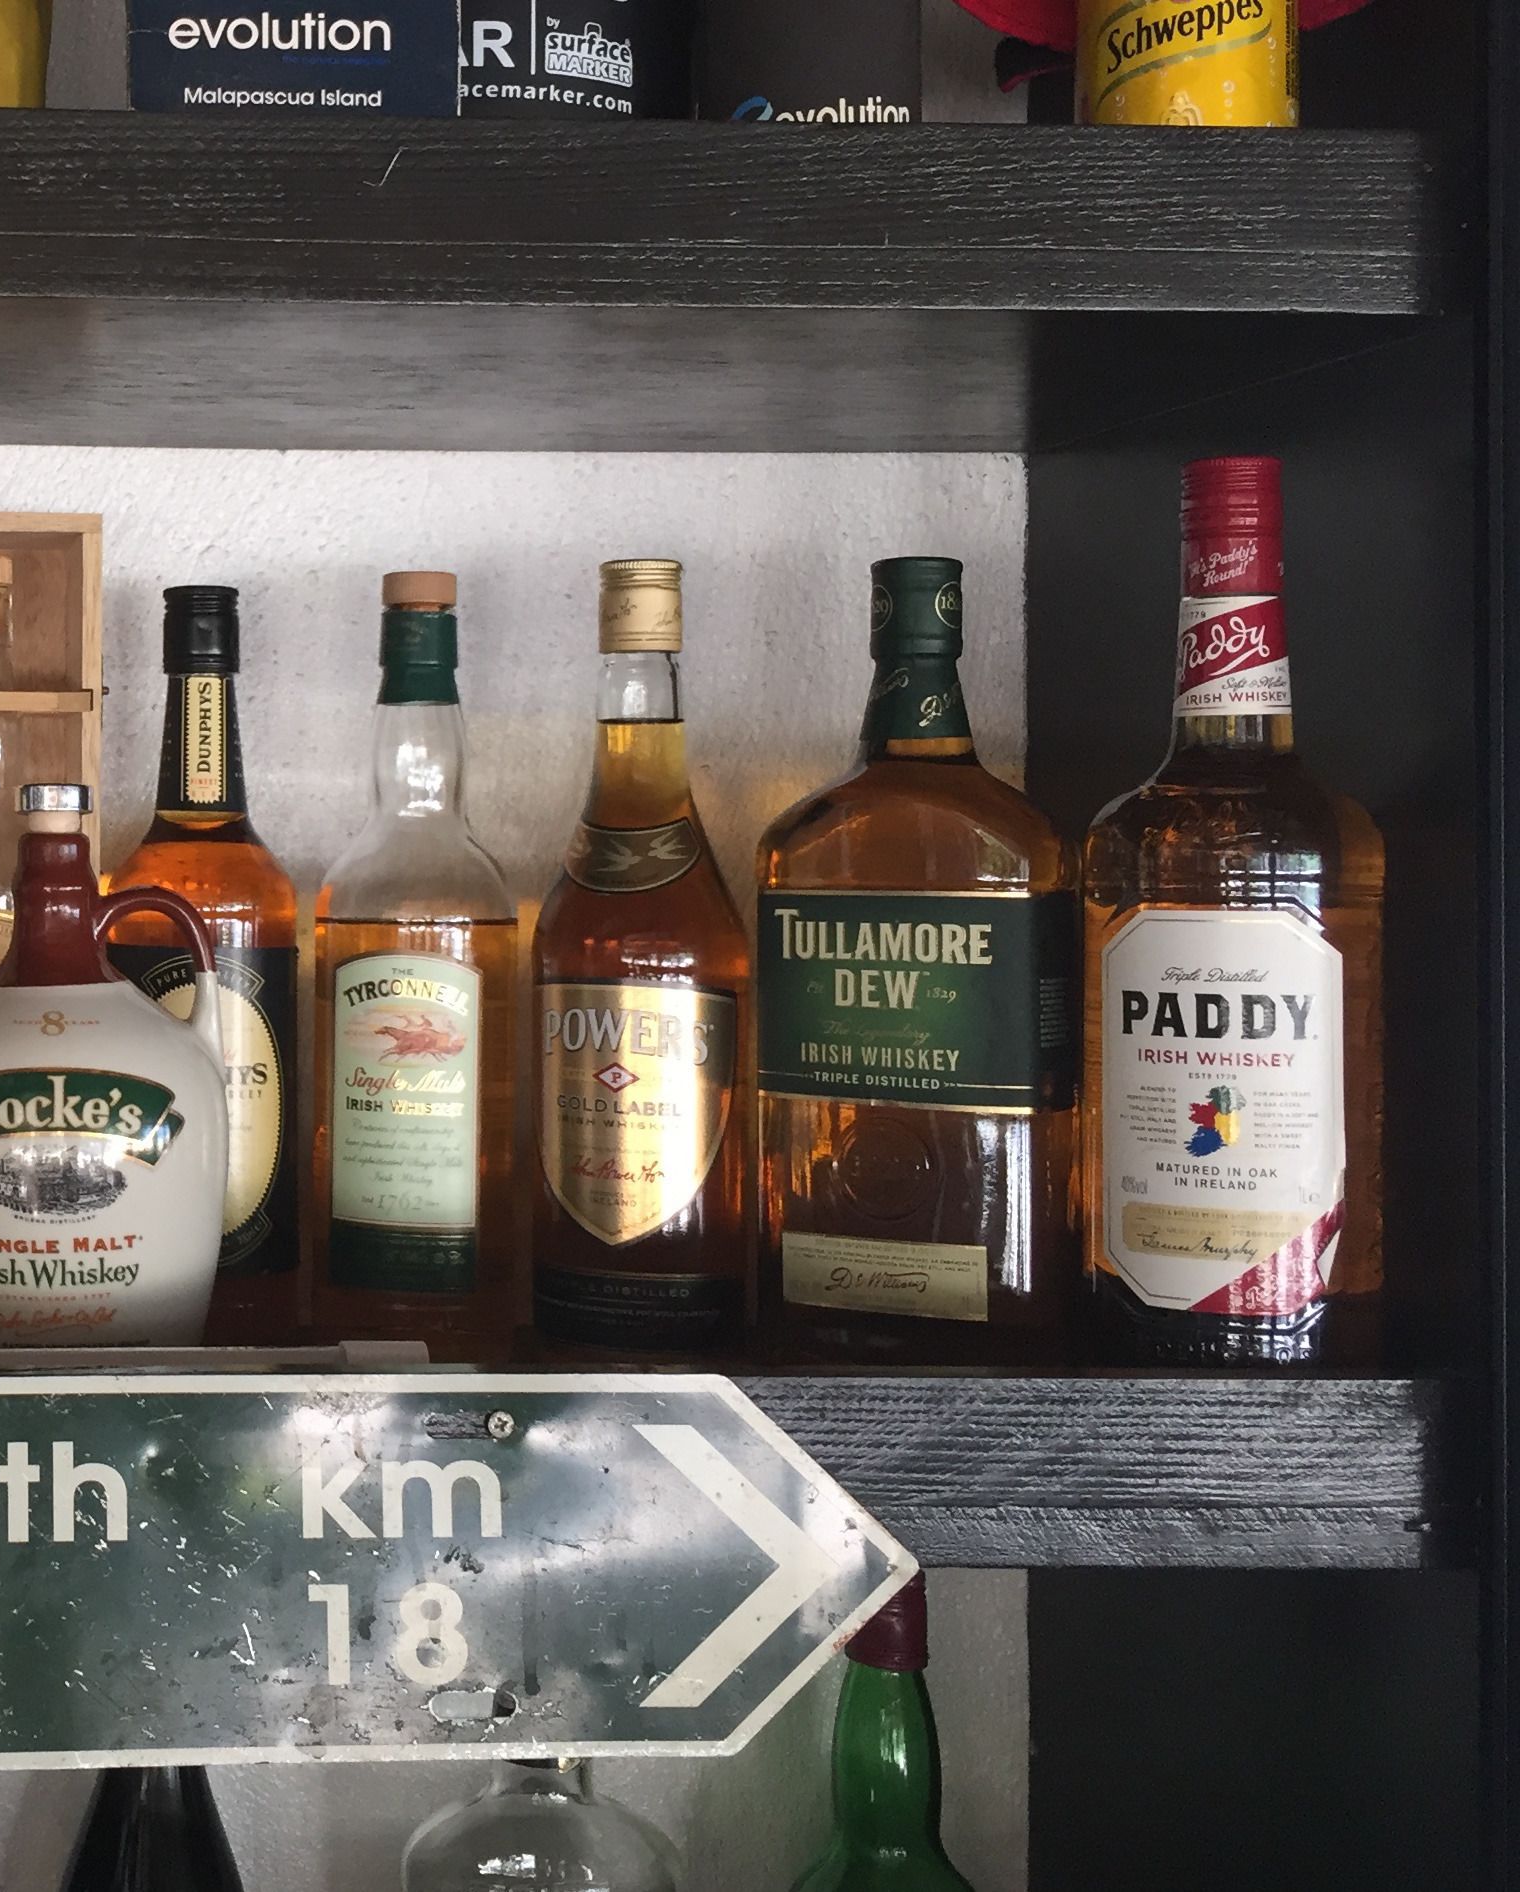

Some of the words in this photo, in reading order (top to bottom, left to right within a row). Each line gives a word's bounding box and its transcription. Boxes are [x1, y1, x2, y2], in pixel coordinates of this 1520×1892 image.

[168, 12, 391, 51] evolution
[546, 16, 560, 29] by
[547, 32, 632, 63] surface
[1107, 0, 1264, 74] Schweppes
[547, 52, 632, 84] MARKER
[184, 87, 314, 107] Malapascua
[321, 89, 382, 107] Island
[1209, 540, 1258, 569] Paddy's
[940, 591, 958, 610] 18
[1180, 616, 1270, 682] Paddy
[1185, 692, 1222, 706] IRISH
[1230, 691, 1287, 704] WHISKEY
[197, 682, 213, 773] DUNPHYS
[774, 908, 993, 965] TULLAMORE
[156, 968, 187, 987] PURE
[391, 967, 414, 976] THE
[1161, 966, 1202, 985] Triple
[1203, 967, 1270, 984] Distilled
[834, 969, 921, 1009] DEW
[926, 987, 957, 1002] 1829
[40, 1010, 66, 1037] 8
[1121, 990, 1317, 1041] PADDY
[543, 1008, 710, 1066] POWERS
[801, 1042, 853, 1064] IRISH
[861, 1046, 960, 1072] WHISKEY
[1137, 1048, 1188, 1065] IRISH
[1197, 1051, 1297, 1068] WHISKEY
[345, 1066, 410, 1097] Single
[610, 1071, 622, 1084] P
[814, 1071, 859, 1085] TRIPLE
[865, 1073, 941, 1090] DISTILLED
[346, 1095, 383, 1113] IRISH
[556, 1094, 608, 1113] GOLD
[613, 1100, 683, 1117] LABEL
[1155, 1162, 1220, 1176] MATURED
[1226, 1167, 1242, 1178] IN
[1248, 1167, 1279, 1178] OAK
[1173, 1176, 1188, 1187] IN
[1194, 1178, 1258, 1191] IRELAND
[377, 1191, 424, 1216] 1762
[73, 1234, 137, 1253] MALT
[28, 1256, 140, 1289] Whiskey
[602, 1284, 691, 1298] DISTILLED
[301, 1438, 502, 1538] km
[307, 1581, 468, 1688] 18
